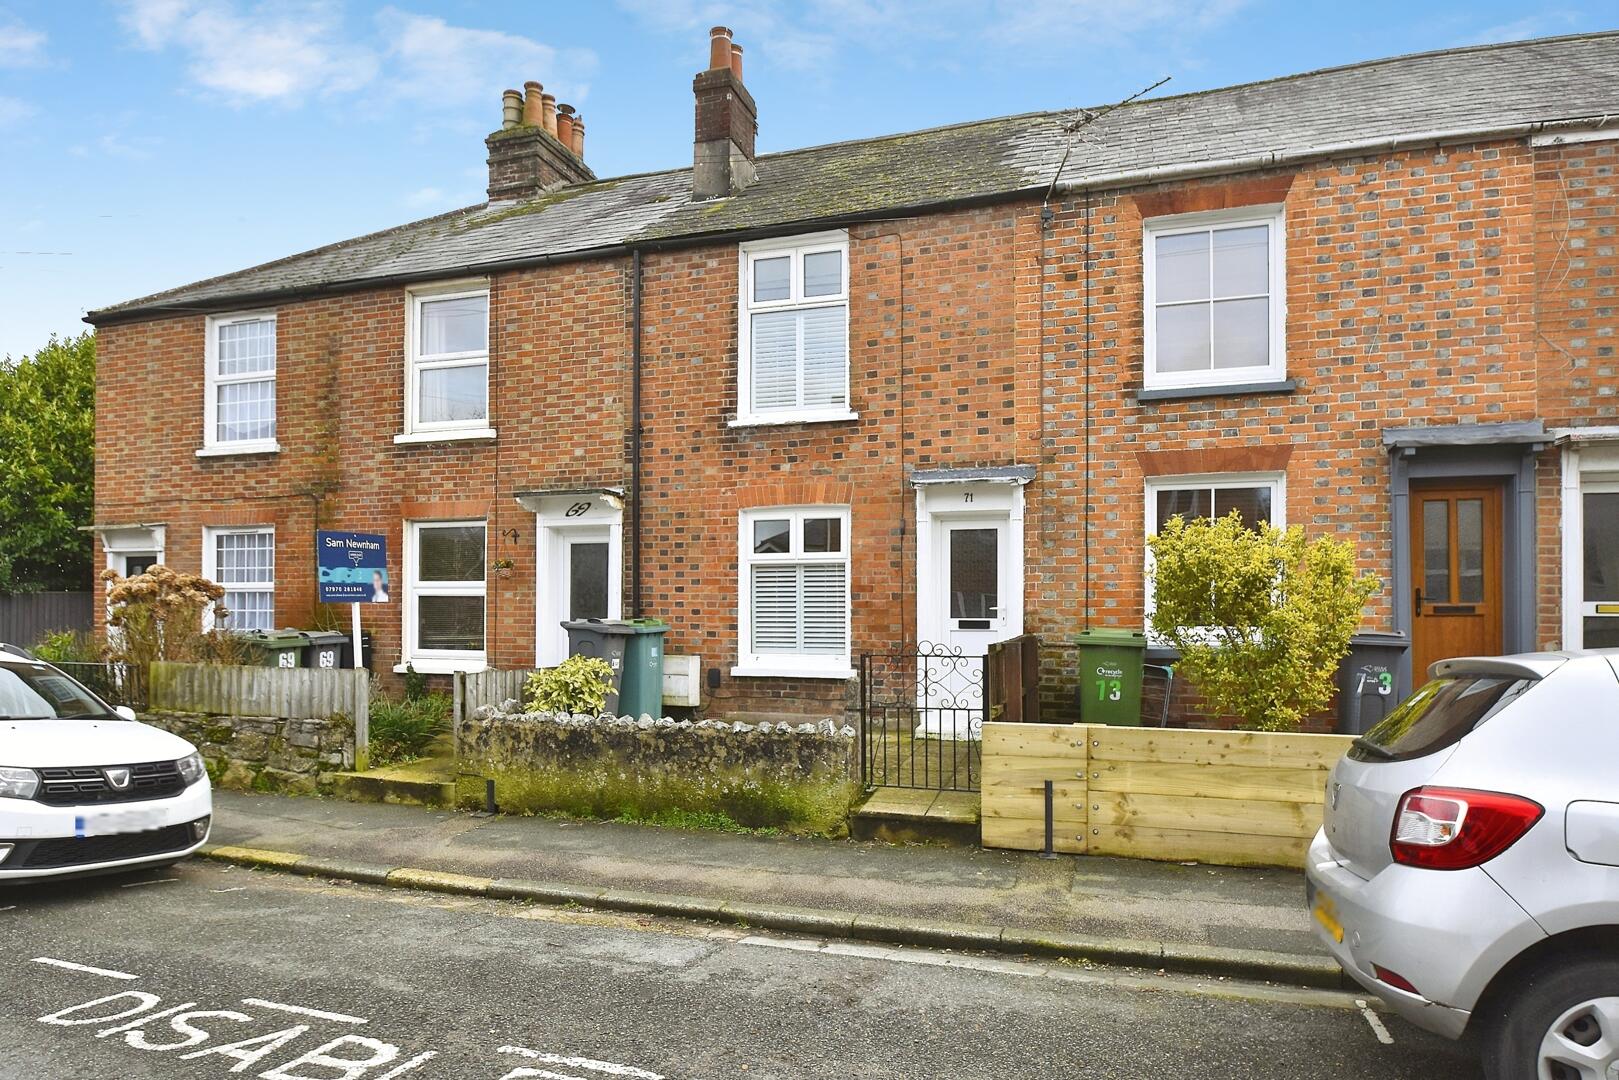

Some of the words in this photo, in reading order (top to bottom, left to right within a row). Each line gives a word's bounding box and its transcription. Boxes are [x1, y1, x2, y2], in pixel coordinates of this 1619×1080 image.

[964, 492, 974, 503] 71
[565, 502, 592, 517] 69
[325, 537, 344, 548] Sam
[345, 538, 380, 550] Newnham
[279, 652, 295, 668] 69
[320, 651, 334, 668] 69
[37, 990, 588, 1080] DISAB
